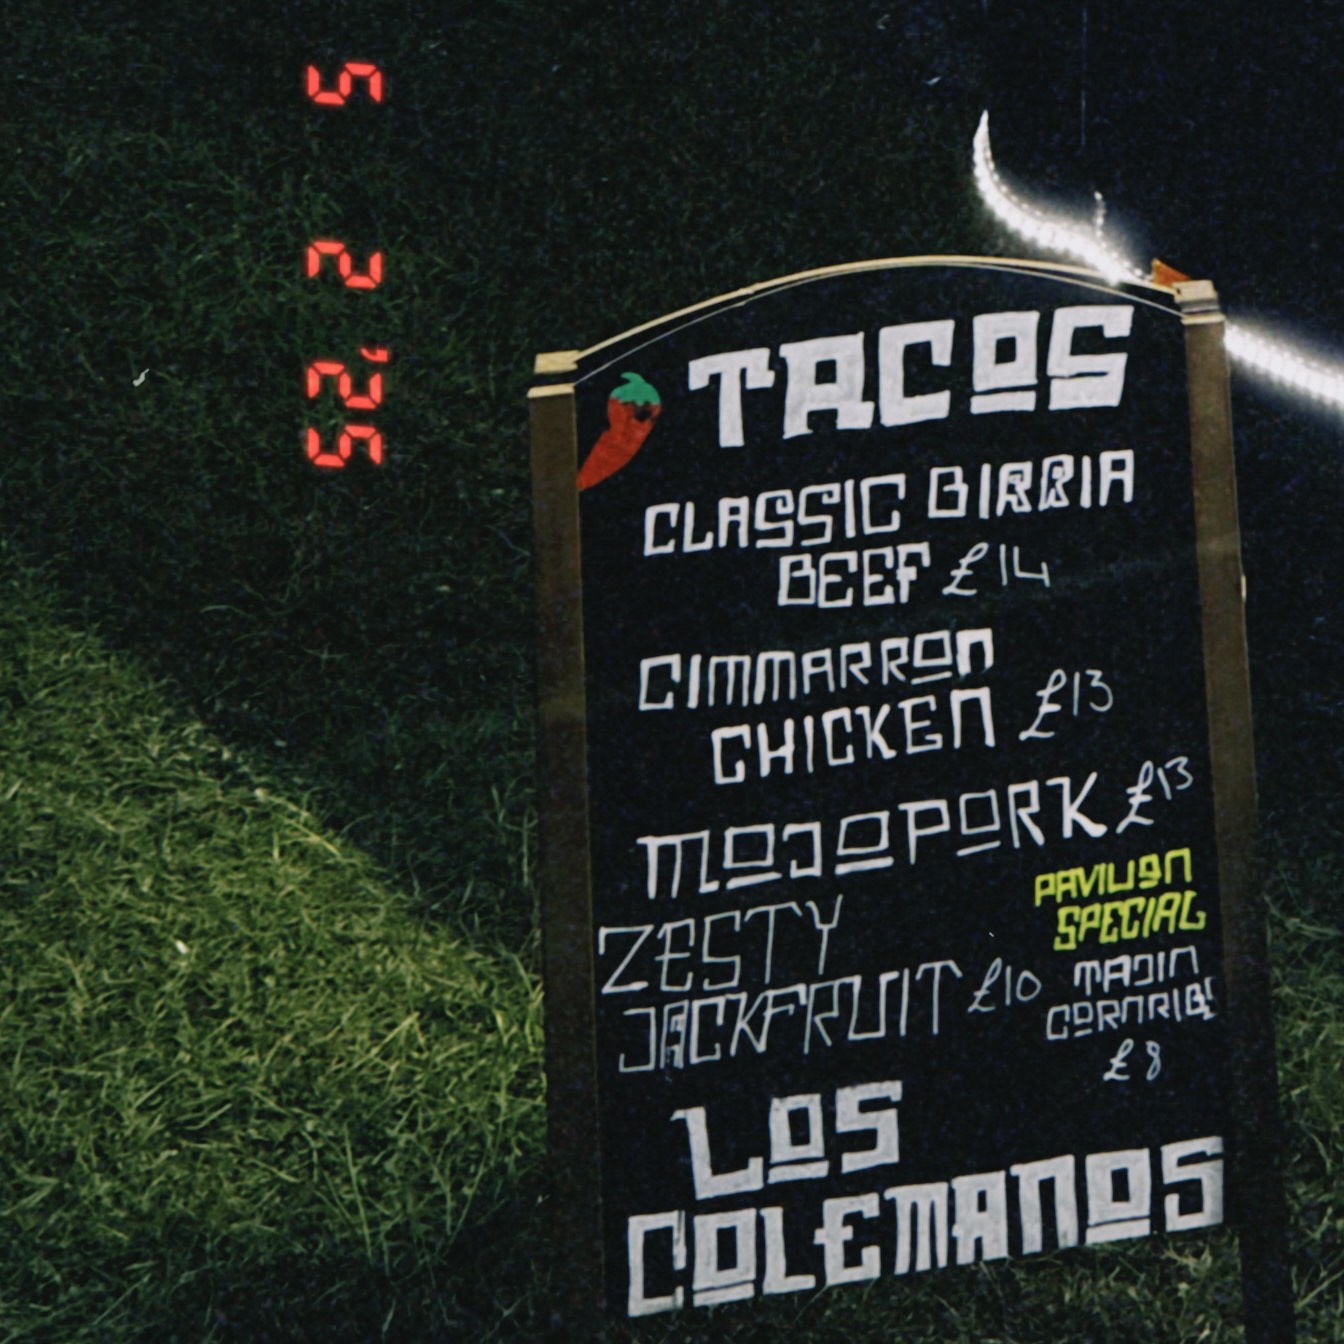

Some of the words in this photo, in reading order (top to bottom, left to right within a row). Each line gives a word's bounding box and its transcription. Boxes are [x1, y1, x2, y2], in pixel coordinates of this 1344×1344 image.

[688, 305, 1134, 448] TACOS
[643, 473, 906, 557] CLASSIC
[926, 449, 1135, 520] BIRRIA
[777, 541, 931, 609] BEEF
[942, 542, 1050, 596] £14
[637, 628, 994, 712] CIMMARRON
[710, 686, 996, 785] CHICKEN
[1019, 668, 1113, 742] £13
[1115, 756, 1193, 834] £13
[598, 894, 843, 995] ZESTY
[1053, 889, 1207, 951] SPECIAL
[618, 959, 963, 1073] JACKFRUIT
[967, 957, 1042, 1013] £10
[670, 1080, 903, 1201] LOS
[627, 1135, 1224, 1318] COLEMANOS
